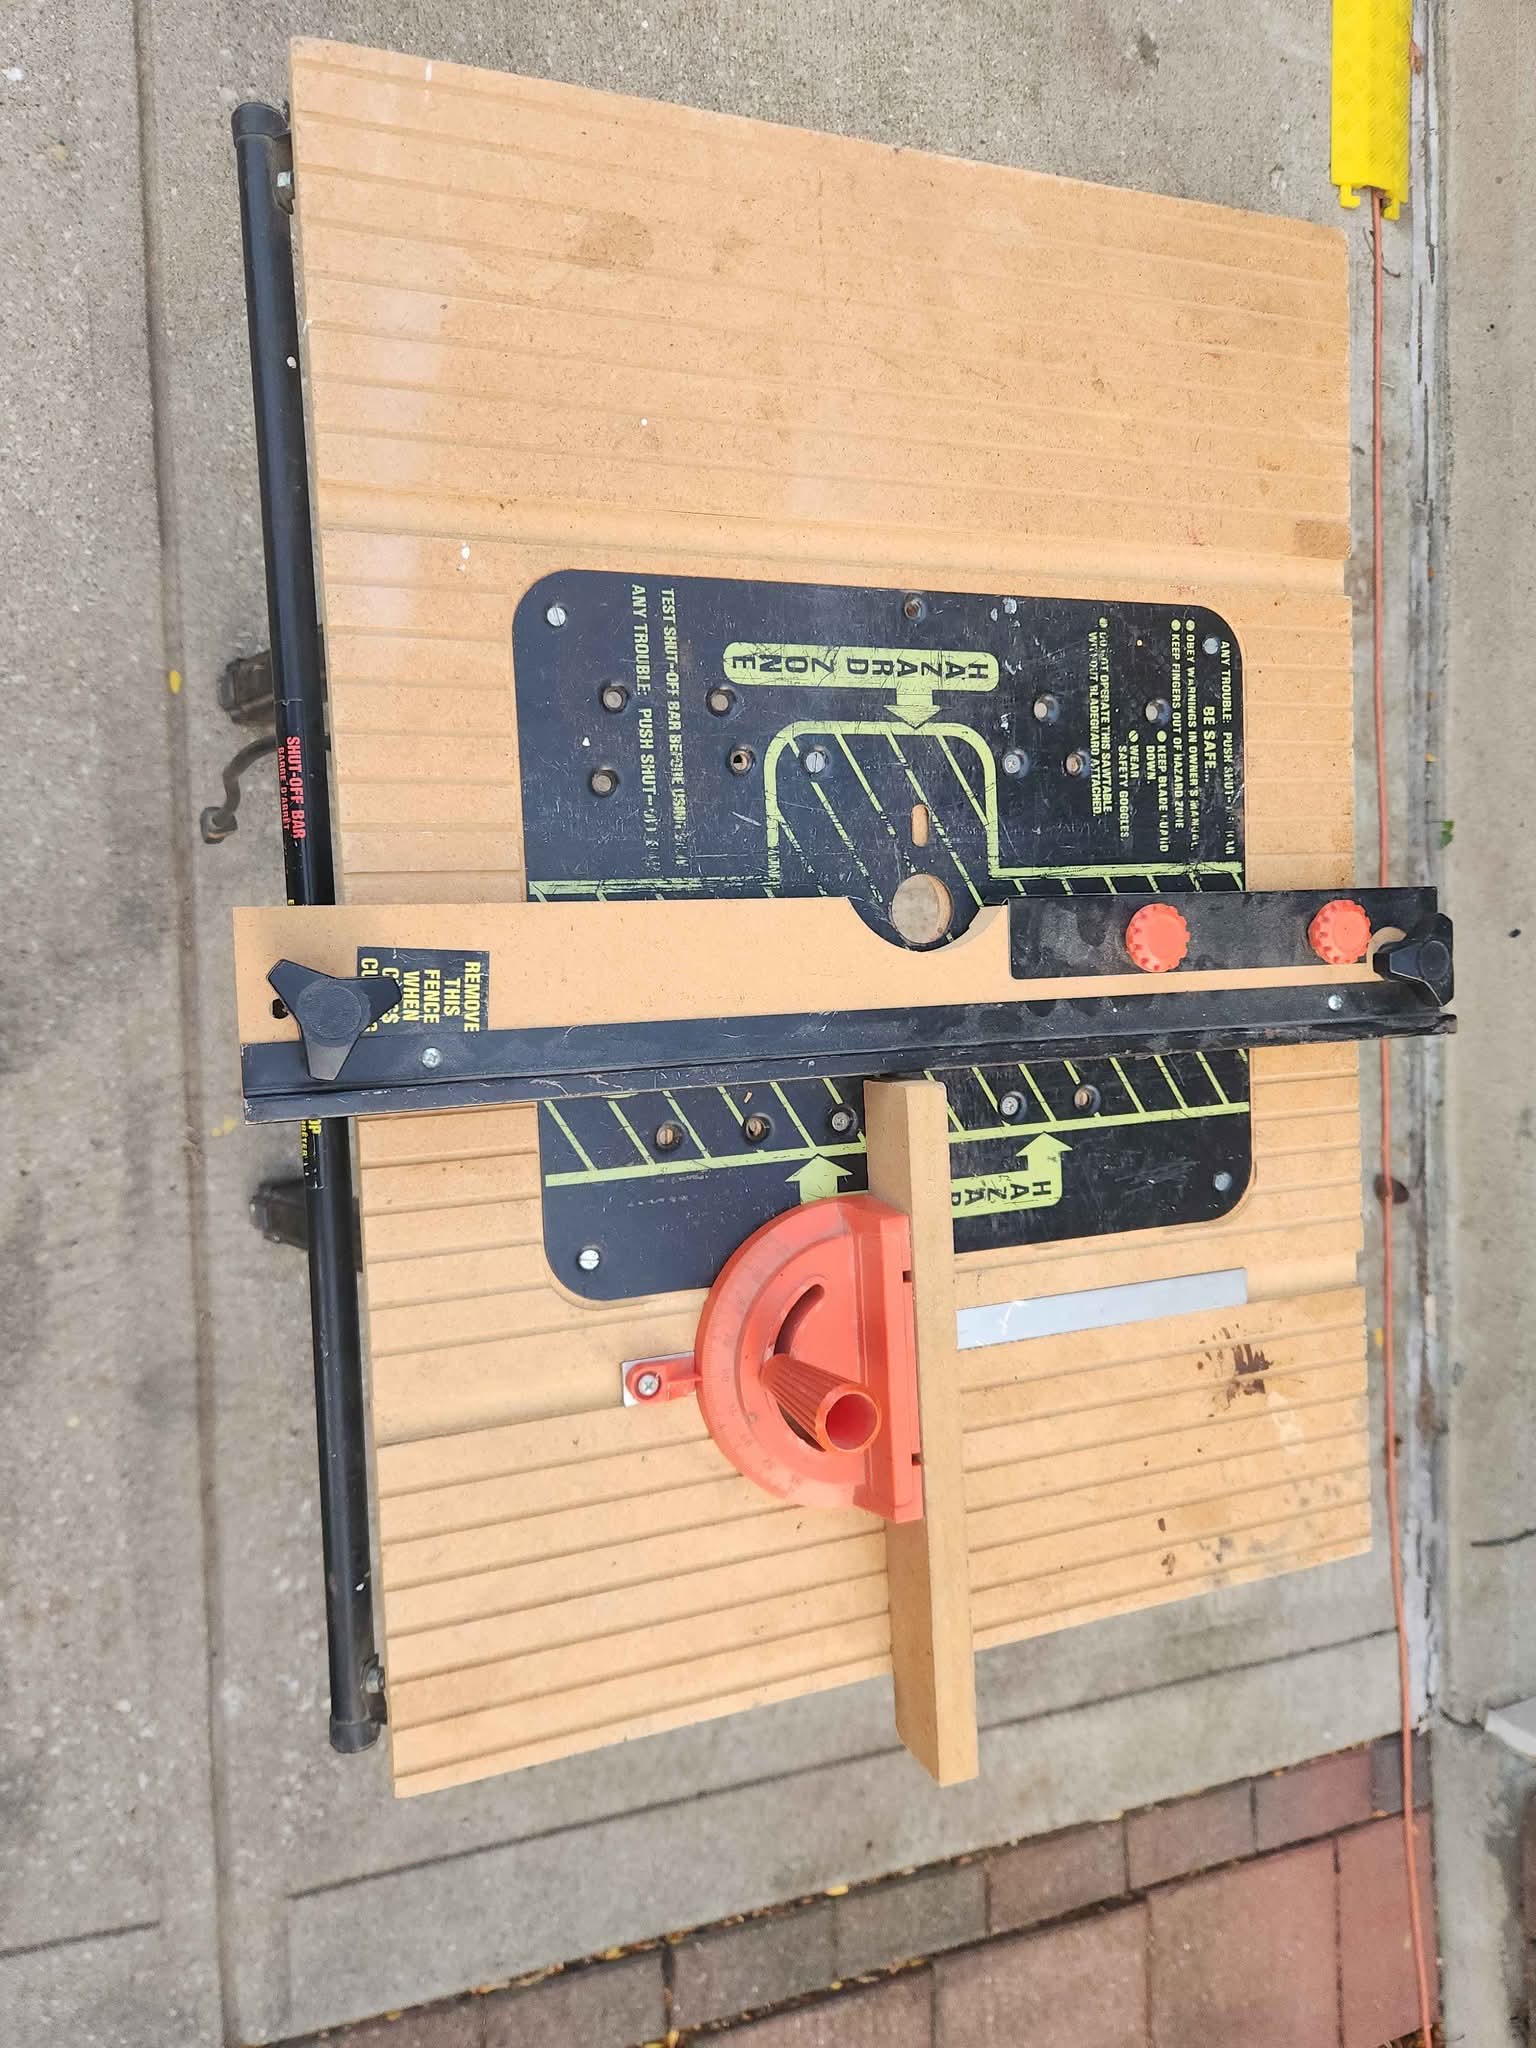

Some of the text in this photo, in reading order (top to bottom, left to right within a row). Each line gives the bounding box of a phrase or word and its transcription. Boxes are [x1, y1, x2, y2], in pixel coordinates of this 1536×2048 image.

[631, 584, 647, 618] ANY
[661, 588, 676, 624] TEST
[633, 623, 651, 696] TROUBLE:
[732, 654, 989, 680] HAZARD ZONE
[1099, 647, 1109, 671] OT
[1171, 634, 1181, 660] KEEP
[1186, 634, 1195, 663] OBEY
[1221, 641, 1231, 666] ANY
[1100, 675, 1111, 722] OPERATE
[1172, 663, 1181, 709] FINGERS
[1187, 667, 1197, 727] WARNINGS
[1222, 669, 1232, 724] TROUBLE:
[638, 708, 654, 749] PUSH
[666, 701, 682, 730] BAR
[1089, 685, 1100, 755] BLADEGUARD
[1173, 712, 1182, 734] OUT
[1101, 726, 1111, 750] THIS
[1173, 737, 1182, 751] OF
[1188, 731, 1198, 742] IN
[1203, 706, 1217, 783] BE SAFE...
[1223, 732, 1233, 762] PUSH
[1129, 744, 1139, 778] WEAR
[1146, 745, 1156, 784] DOWN.
[1157, 745, 1167, 772] KEEP
[1174, 754, 1184, 798] HAZARD
[1189, 746, 1199, 797] OWNER'S
[278, 746, 292, 831] BARRE D'ARRÊT
[286, 736, 307, 839] SHUT-OFF BAR
[1091, 759, 1102, 817] ATTACHED.
[1102, 752, 1113, 813] SAWTABLE
[1118, 745, 1129, 842] SAFETY GOGGLES.
[1158, 776, 1168, 811] BLADE
[402, 970, 420, 1021] WHEN
[423, 969, 441, 1024] FENCE
[444, 977, 461, 1017] THIS
[464, 961, 481, 1033] REMOVE
